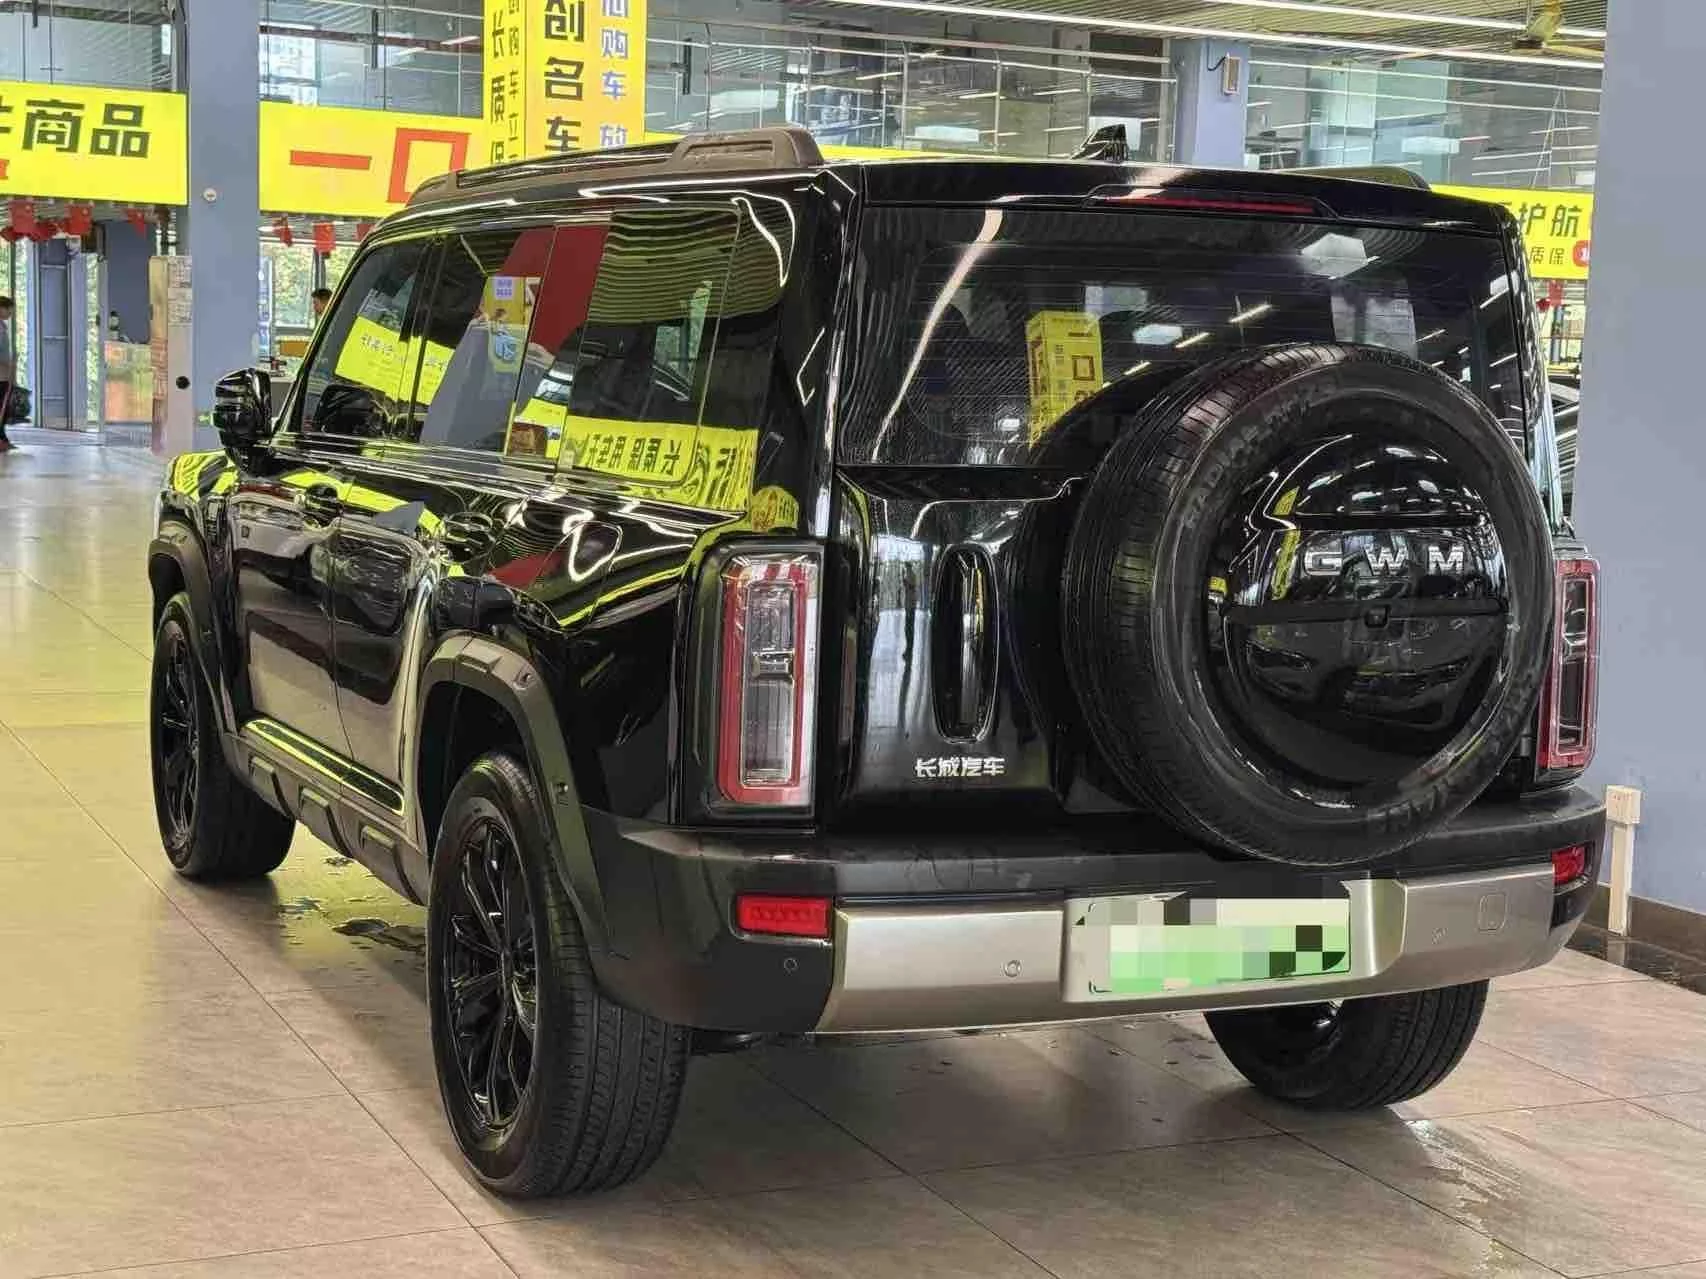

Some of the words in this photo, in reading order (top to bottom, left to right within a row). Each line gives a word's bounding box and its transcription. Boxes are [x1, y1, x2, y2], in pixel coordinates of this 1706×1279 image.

[1303, 544, 1465, 576] GWM
[914, 756, 1006, 778] 长城汽车
